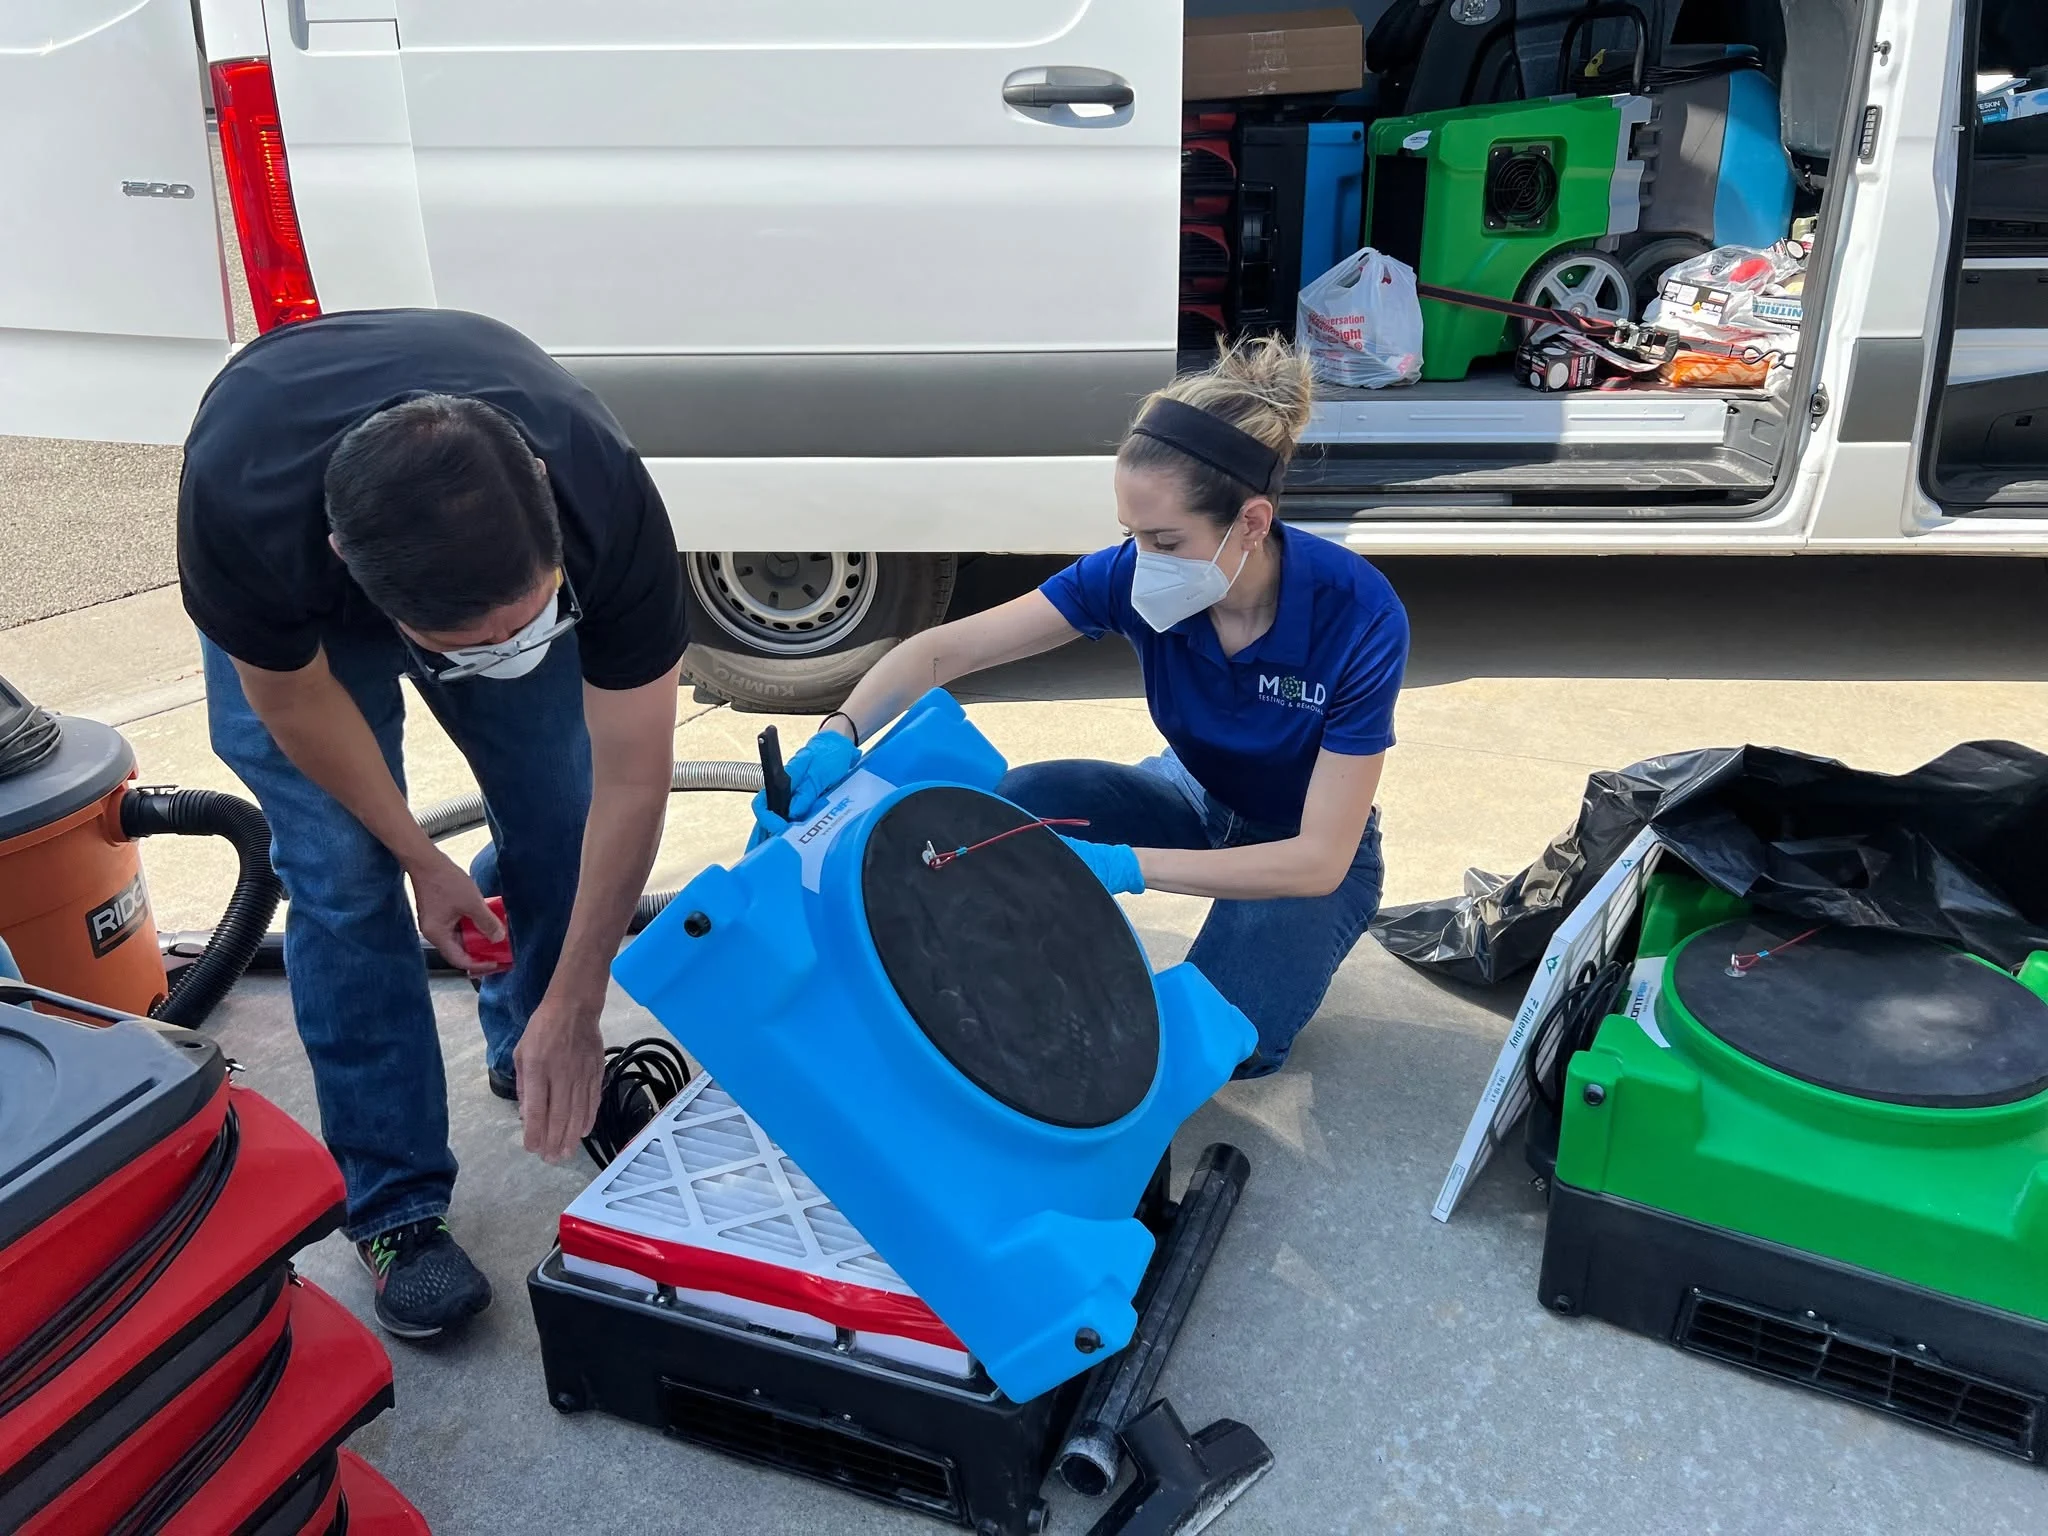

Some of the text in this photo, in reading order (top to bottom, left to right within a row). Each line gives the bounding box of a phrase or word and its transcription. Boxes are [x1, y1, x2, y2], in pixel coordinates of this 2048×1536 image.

[1752, 304, 1803, 318] NITRILE
[713, 667, 796, 697] KUMHO
[1259, 674, 1326, 705] MOLD
[1258, 694, 1285, 706] TESTING
[1296, 702, 1324, 716] REMOVAL
[799, 796, 853, 844] CONTAIR
[1630, 980, 1649, 1019] ONTAIR
[1508, 1005, 1535, 1049] Filterbuy
